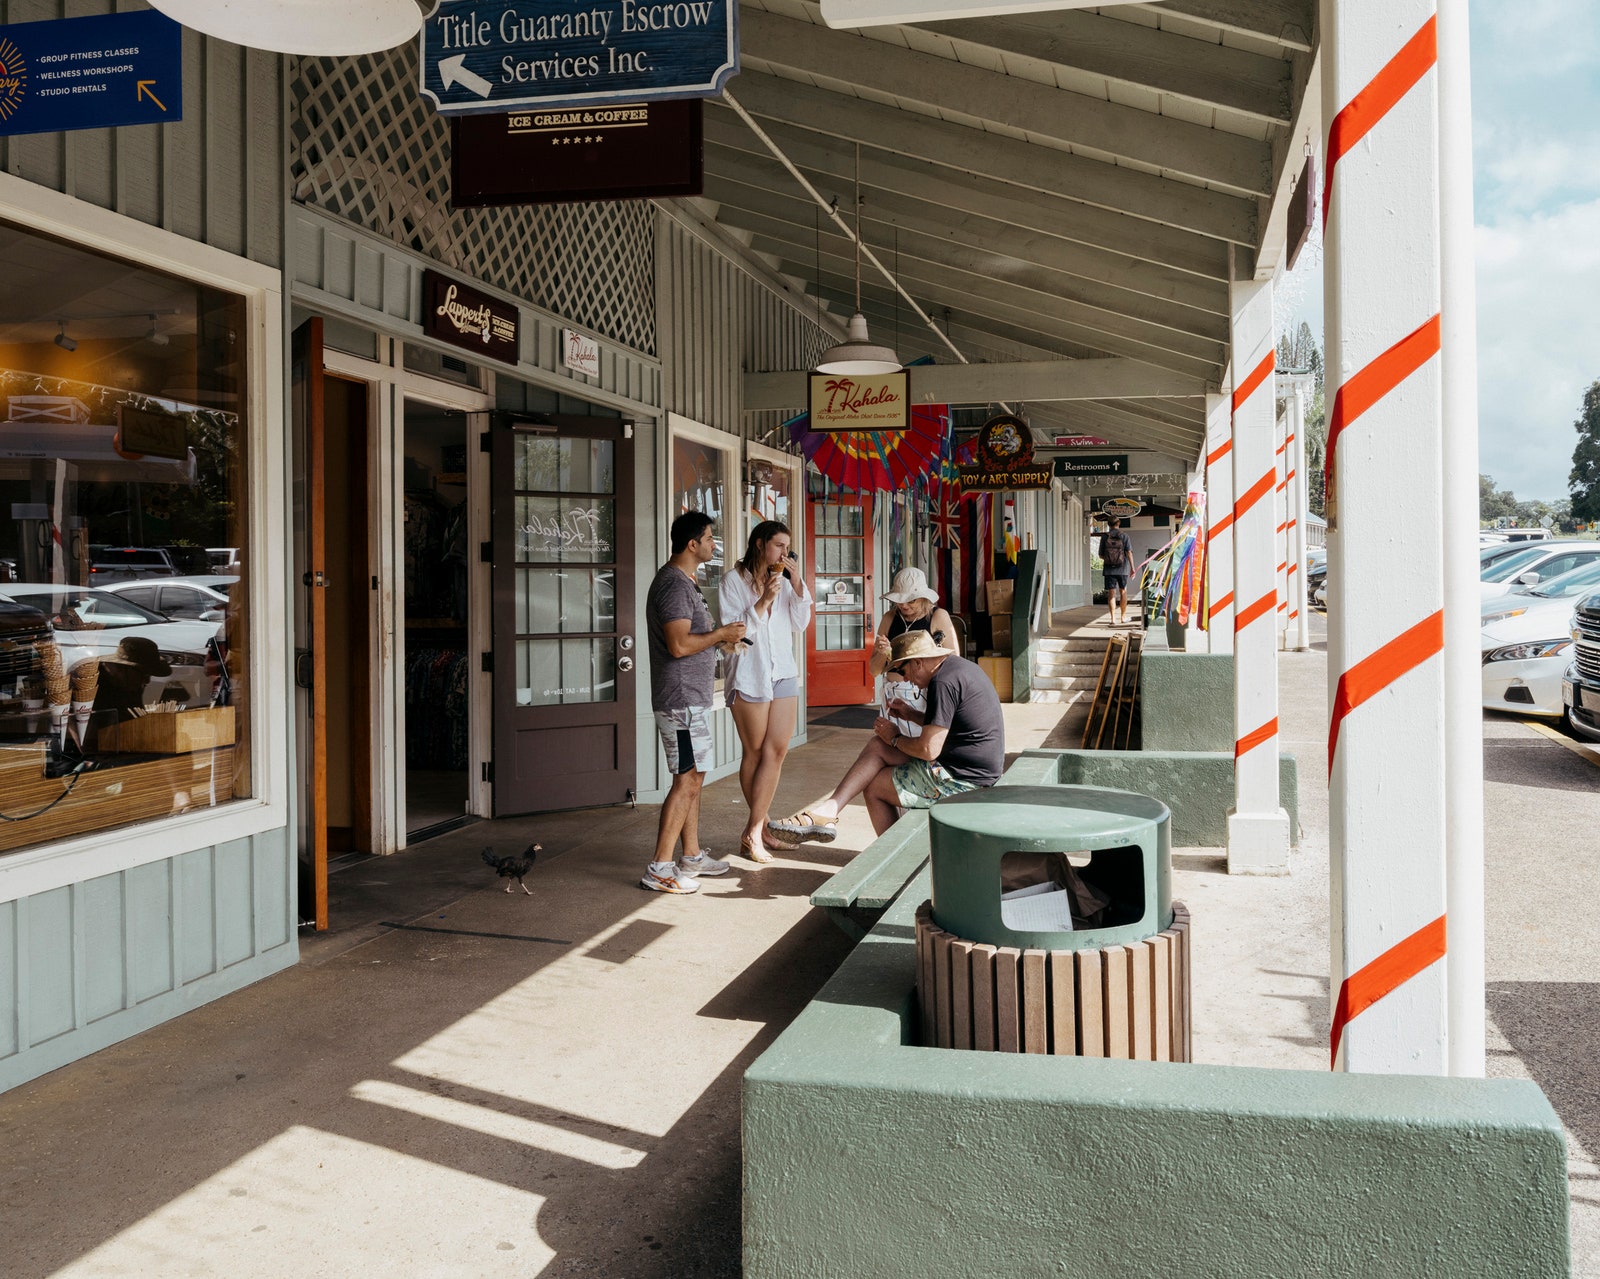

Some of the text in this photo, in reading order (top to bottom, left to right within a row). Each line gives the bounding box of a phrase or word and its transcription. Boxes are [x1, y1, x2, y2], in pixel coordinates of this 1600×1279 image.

[438, 0, 713, 49] Title Guaranty Escrow
[40, 47, 139, 63] GROUP FITNESS CLASSES
[40, 65, 134, 80] WELLNESS WORKSHOPS
[501, 47, 654, 84] Services Inc.
[40, 84, 107, 96] STUDIO RENTALS
[508, 109, 648, 127] ICE CREAM & COFFEE
[1064, 461, 1110, 471] Restrooms
[962, 474, 979, 485] TOY
[988, 473, 1009, 485] ART
[1012, 471, 1049, 485] SUPPLY
